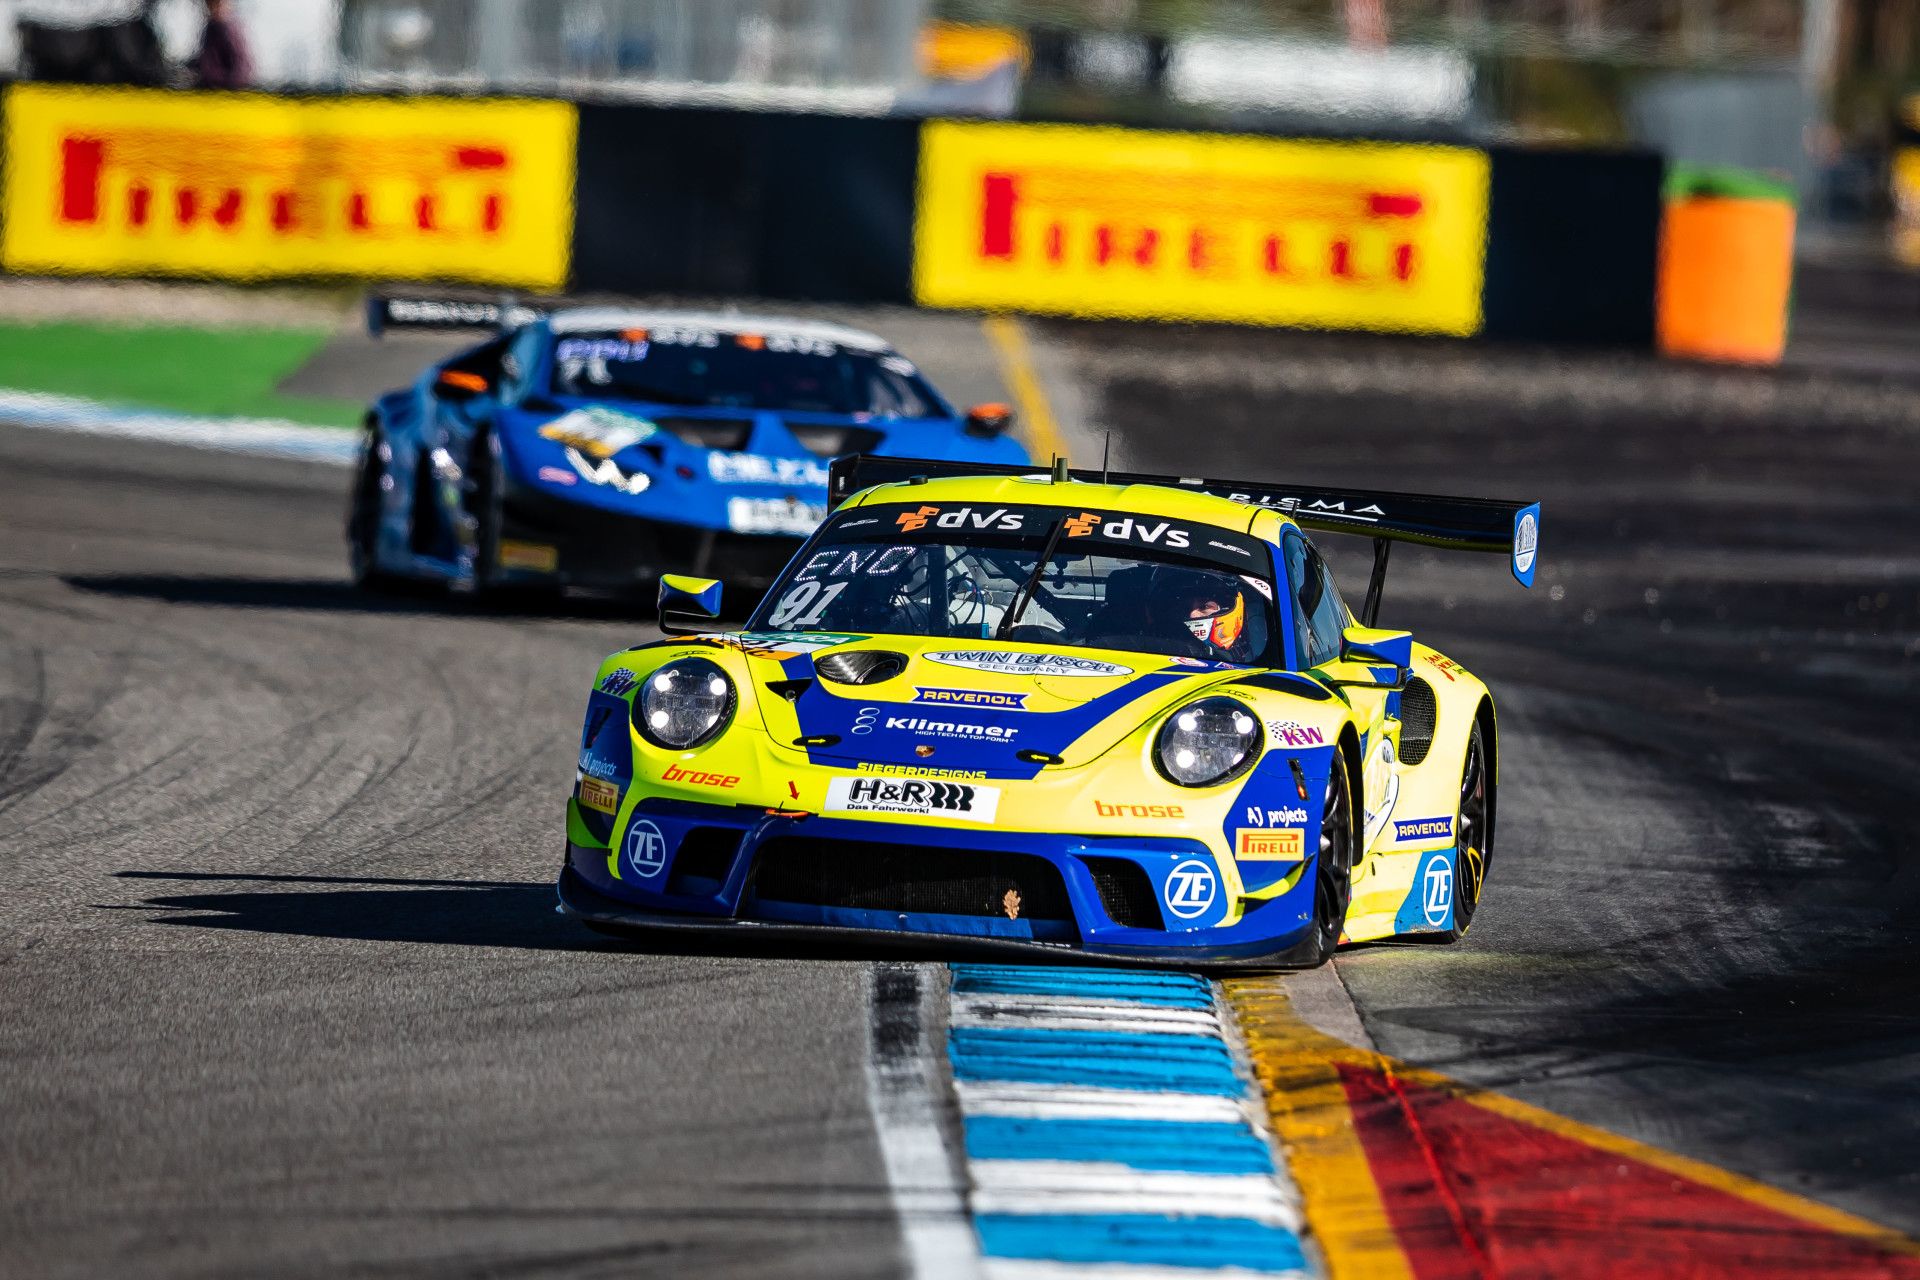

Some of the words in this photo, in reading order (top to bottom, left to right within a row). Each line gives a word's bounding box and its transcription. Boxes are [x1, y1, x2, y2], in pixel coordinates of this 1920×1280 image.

[60, 136, 507, 234] PIRELLI
[981, 172, 1424, 282] PIRELLI
[1203, 490, 1386, 516] RISMA
[768, 581, 849, 626] 91
[936, 651, 1013, 664] TWIN
[1015, 653, 1116, 672] BUSCH
[978, 663, 1071, 674] GERMANY
[923, 690, 1018, 706] RAVENOL
[885, 717, 1019, 738] Klimmer
[1281, 726, 1324, 746] KW
[985, 736, 1009, 744] FORM
[661, 763, 741, 788] brose
[856, 762, 987, 780] SIEGERDESIGNS
[582, 780, 615, 809] PIRELLI
[849, 778, 930, 807] H&R
[846, 803, 869, 811] Das
[871, 804, 929, 814] Fahrwerk!
[1094, 800, 1185, 818] brose
[1246, 806, 1264, 828] AJ
[1267, 805, 1308, 828] projects
[1399, 821, 1449, 837] RAVENOL
[630, 827, 664, 868] ZF
[1242, 833, 1299, 853] PIRELLI
[1169, 871, 1213, 908] ZF
[1425, 870, 1453, 914] ZF
